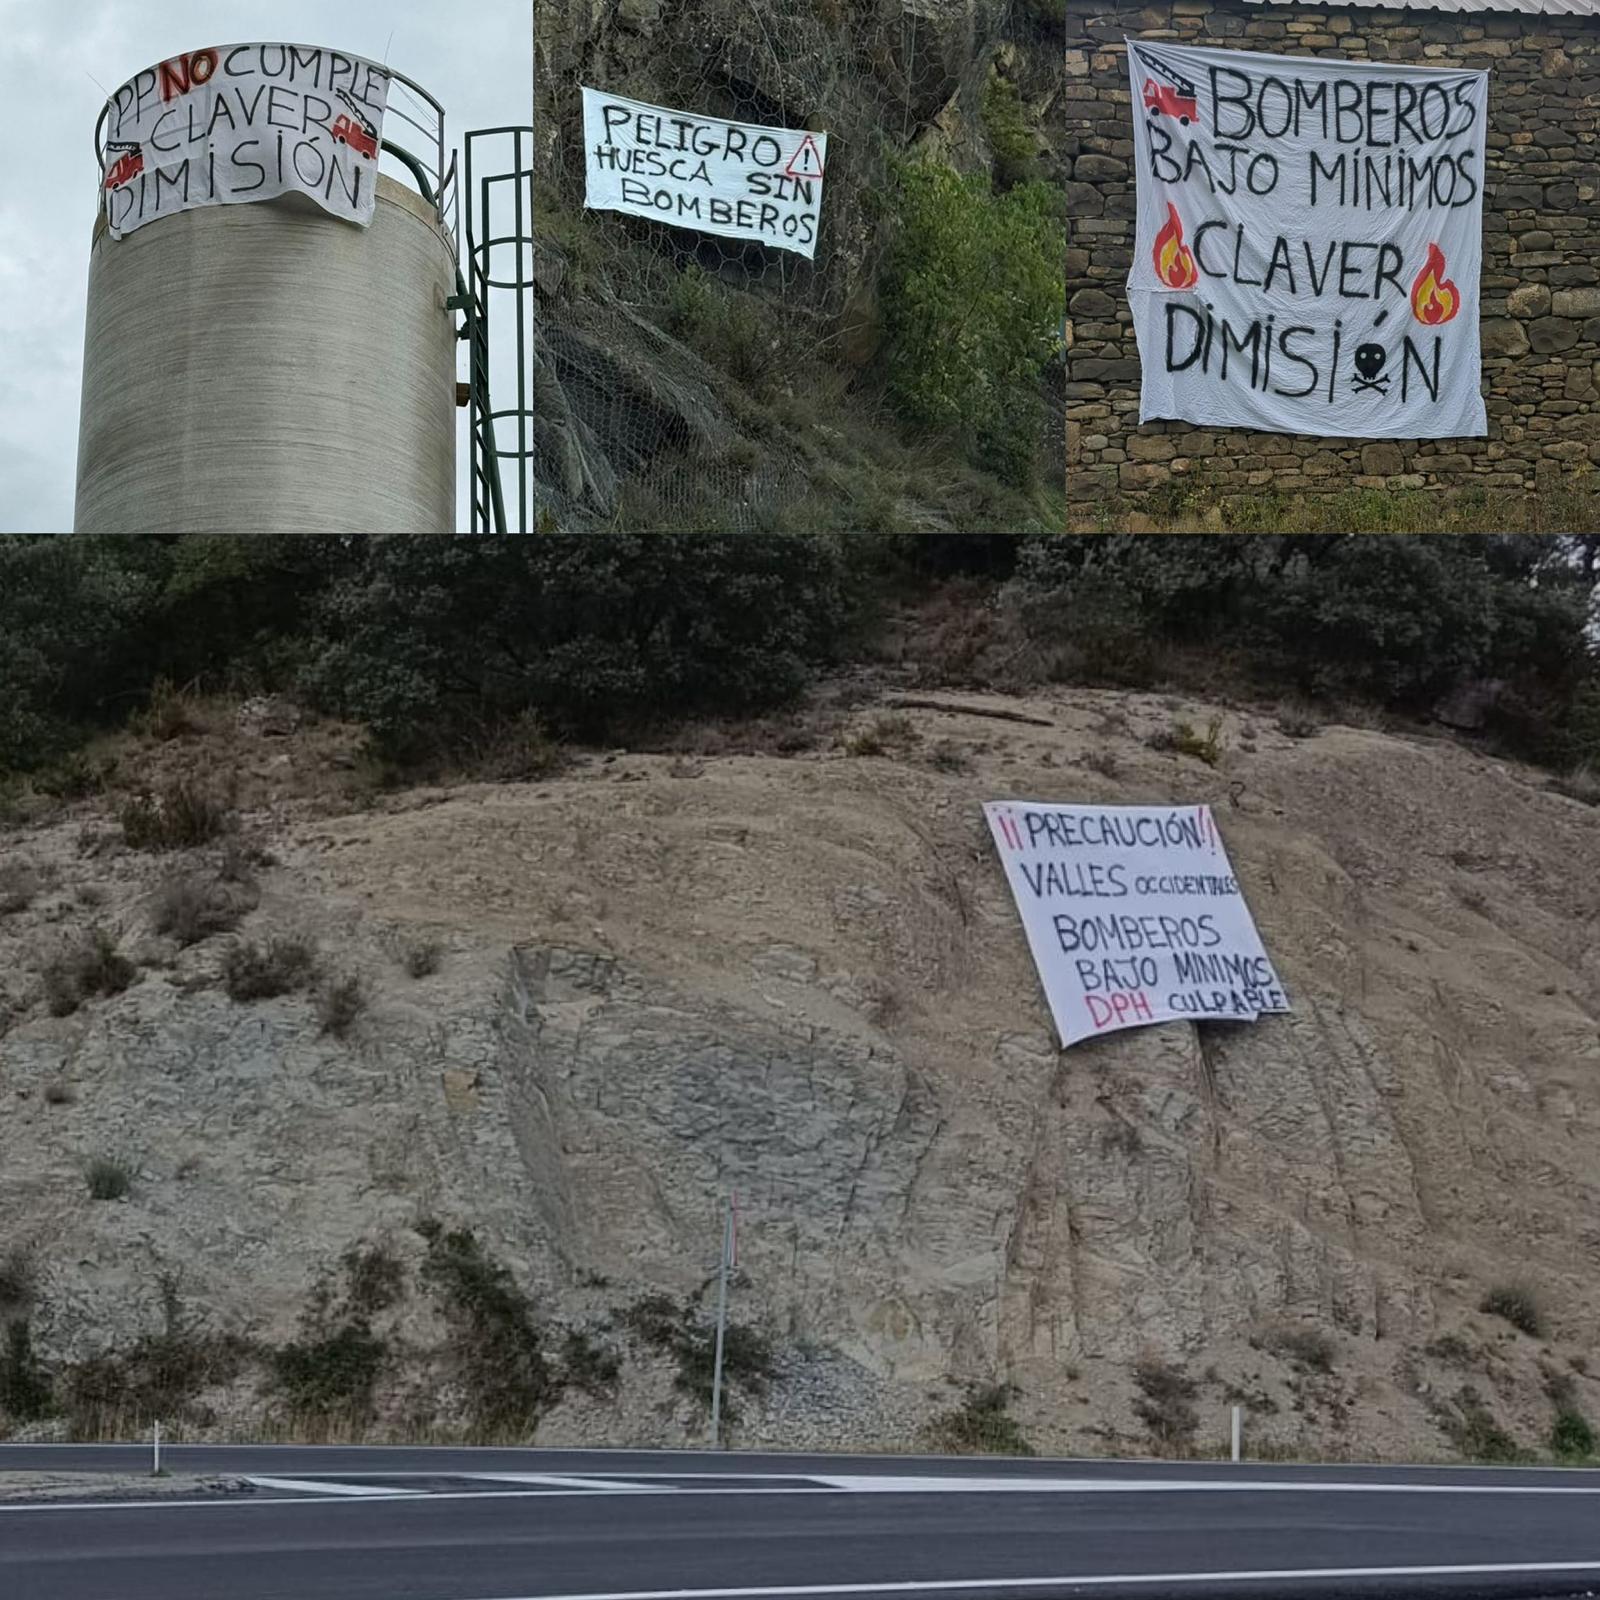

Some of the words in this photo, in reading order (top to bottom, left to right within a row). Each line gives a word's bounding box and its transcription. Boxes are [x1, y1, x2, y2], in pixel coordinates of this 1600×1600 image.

[114, 69, 157, 138] PP
[160, 48, 219, 104] NO
[224, 44, 390, 112] CUMPLE
[150, 84, 336, 151] CLAVER
[1209, 65, 1478, 147] BOMBEROS
[602, 105, 782, 167] PELIGRO
[1147, 120, 1279, 195] BAJO
[594, 145, 713, 186] HUESCA
[746, 172, 813, 205] SIN
[622, 177, 815, 243] BOMBEROS
[1193, 220, 1407, 299] CLAVER
[1020, 862, 1128, 898] VALLES
[1135, 875, 1239, 895] OCCIDENTALES
[1053, 914, 1222, 952] BOMBEROS
[1076, 957, 1158, 991] BAJO
[1085, 992, 1154, 1028] DPH
[1168, 989, 1286, 1014] CULPABLE
